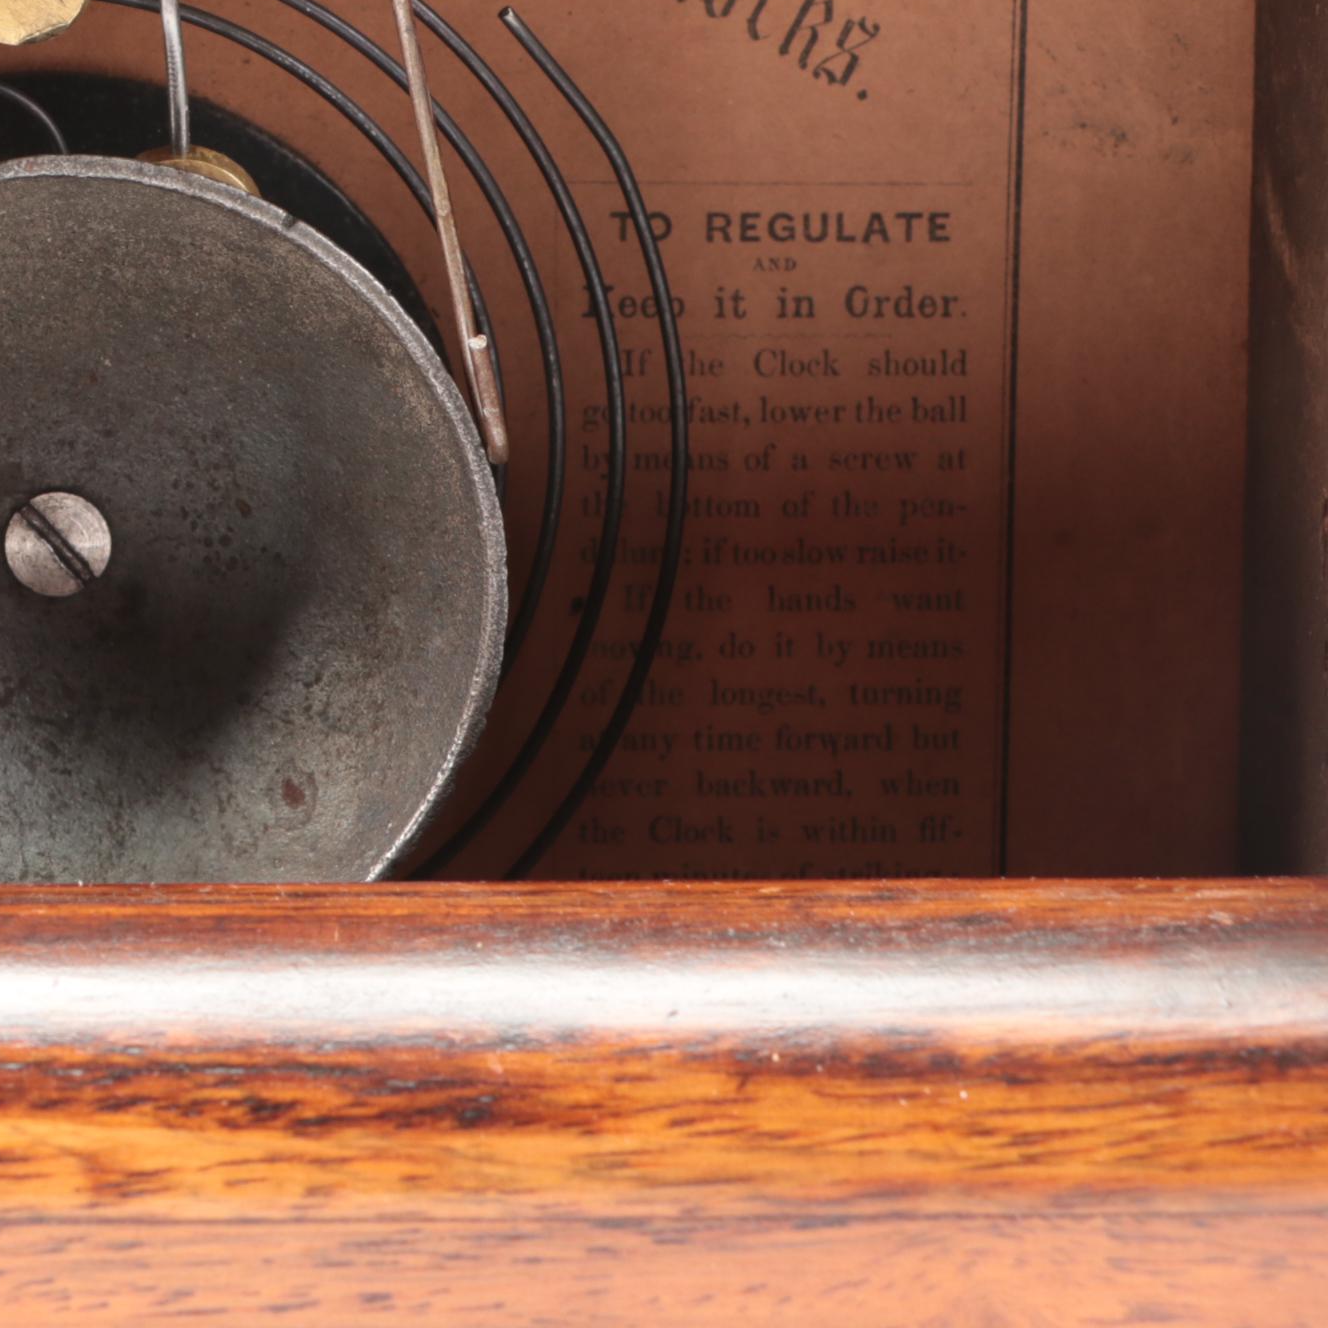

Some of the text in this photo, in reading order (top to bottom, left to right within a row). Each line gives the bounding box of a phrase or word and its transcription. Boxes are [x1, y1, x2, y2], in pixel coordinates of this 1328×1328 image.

[608, 211, 953, 244] TO REGULATE
[752, 256, 799, 273] AND
[713, 285, 748, 320] it
[776, 285, 817, 320] in
[844, 283, 968, 320] Order.
[622, 348, 969, 378] If he Clock should
[685, 395, 752, 428] fast,
[759, 395, 850, 425] lower
[854, 395, 903, 425] the
[911, 395, 969, 425] ball
[743, 442, 778, 472] of
[791, 451, 809, 472] a
[829, 451, 919, 473] screw
[937, 447, 967, 472] at
[656, 489, 762, 519] bttom
[780, 490, 816, 519] of
[831, 489, 880, 518] the
[899, 497, 969, 527] pen-
[702, 536, 728, 565] if
[733, 541, 777, 566] too
[782, 537, 849, 566] slow
[856, 536, 930, 565] raise
[623, 583, 965, 613] If the hands want
[718, 631, 756, 660] do
[774, 632, 795, 658] it
[815, 631, 853, 668] by
[866, 638, 965, 660] means
[579, 677, 615, 706] of
[710, 677, 828, 715] longest,
[849, 676, 963, 714] turning
[622, 732, 680, 762] any
[692, 725, 763, 753] time
[775, 722, 895, 758] forward
[912, 723, 962, 753] but
[695, 767, 854, 800] backward,
[880, 768, 962, 798] when
[577, 815, 626, 845] the
[647, 814, 735, 845] Clock
[756, 815, 782, 844] is
[800, 815, 898, 844] within
